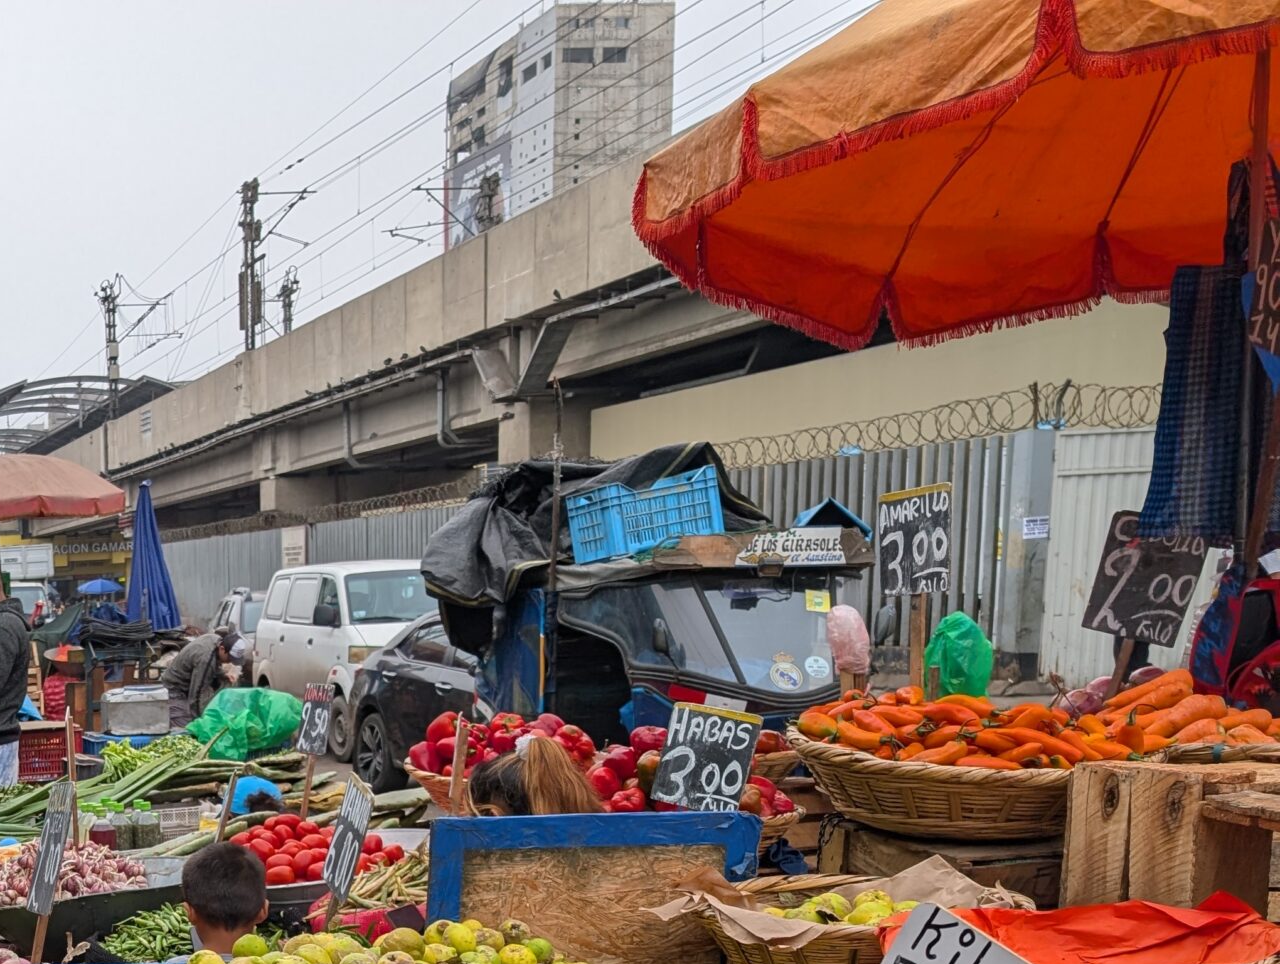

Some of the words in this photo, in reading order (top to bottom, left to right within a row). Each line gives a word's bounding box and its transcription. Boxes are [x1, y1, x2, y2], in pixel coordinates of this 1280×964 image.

[880, 489, 949, 535] AMARILLO
[761, 539, 778, 552] LOS
[667, 706, 753, 750] HABAS
